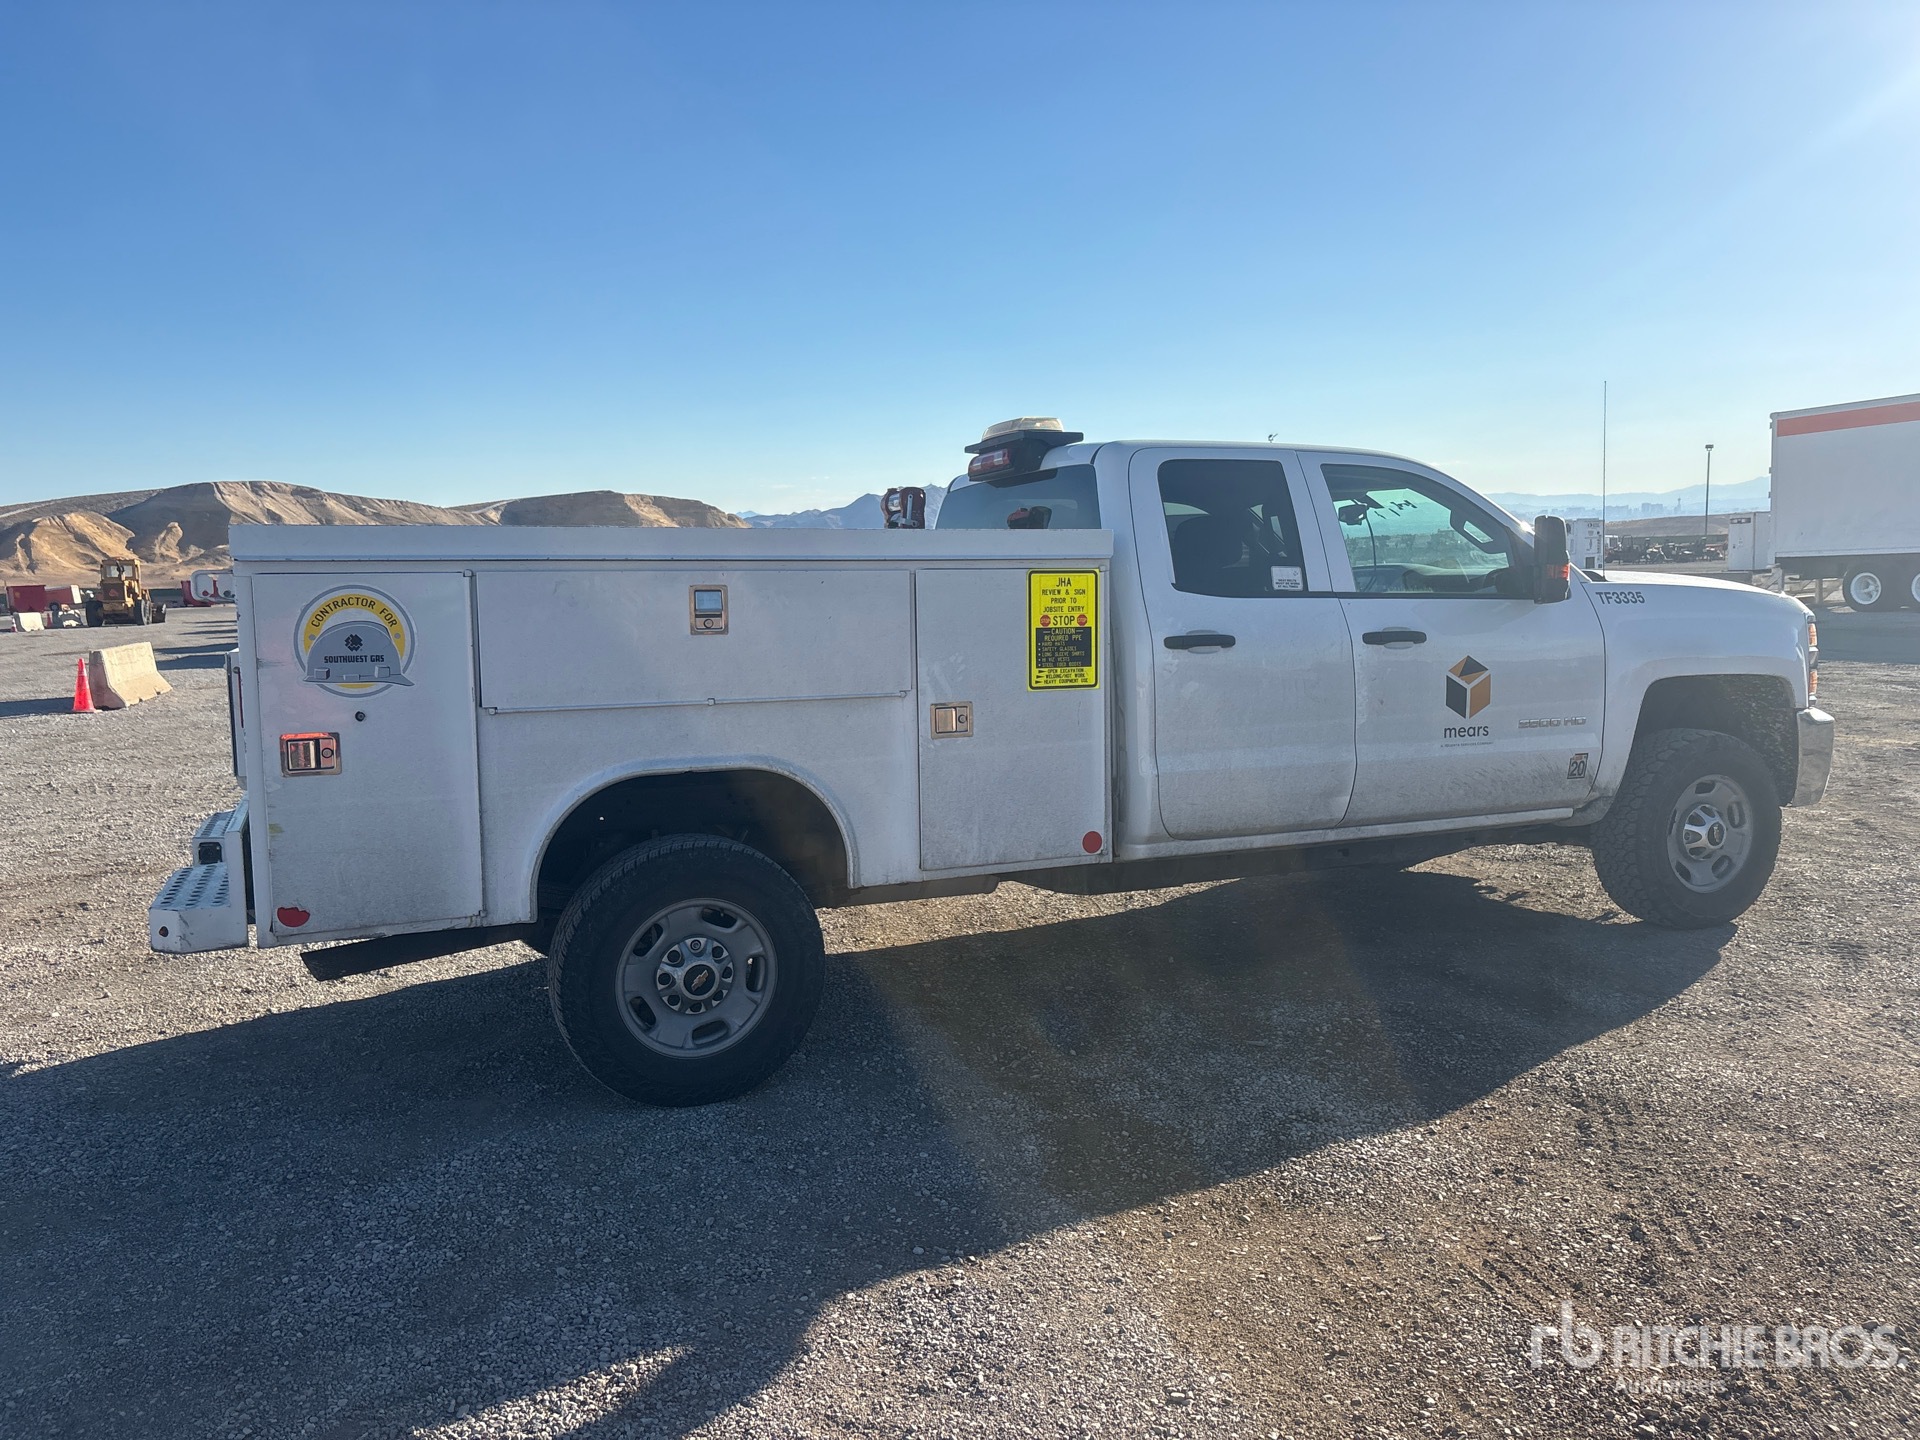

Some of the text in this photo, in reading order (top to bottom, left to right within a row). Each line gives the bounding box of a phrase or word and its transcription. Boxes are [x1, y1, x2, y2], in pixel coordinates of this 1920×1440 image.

[1056, 577, 1072, 587] JHA
[1595, 591, 1646, 605] TF3335
[311, 596, 398, 628] CONTRACTOR FOR
[1043, 605, 1064, 613] JOBSITE
[1052, 615, 1075, 626] STOP
[324, 654, 385, 664] SOUTHWEST GAS
[1563, 716, 1586, 727] HD
[1443, 725, 1489, 738] mears
[1570, 760, 1585, 776] 20
